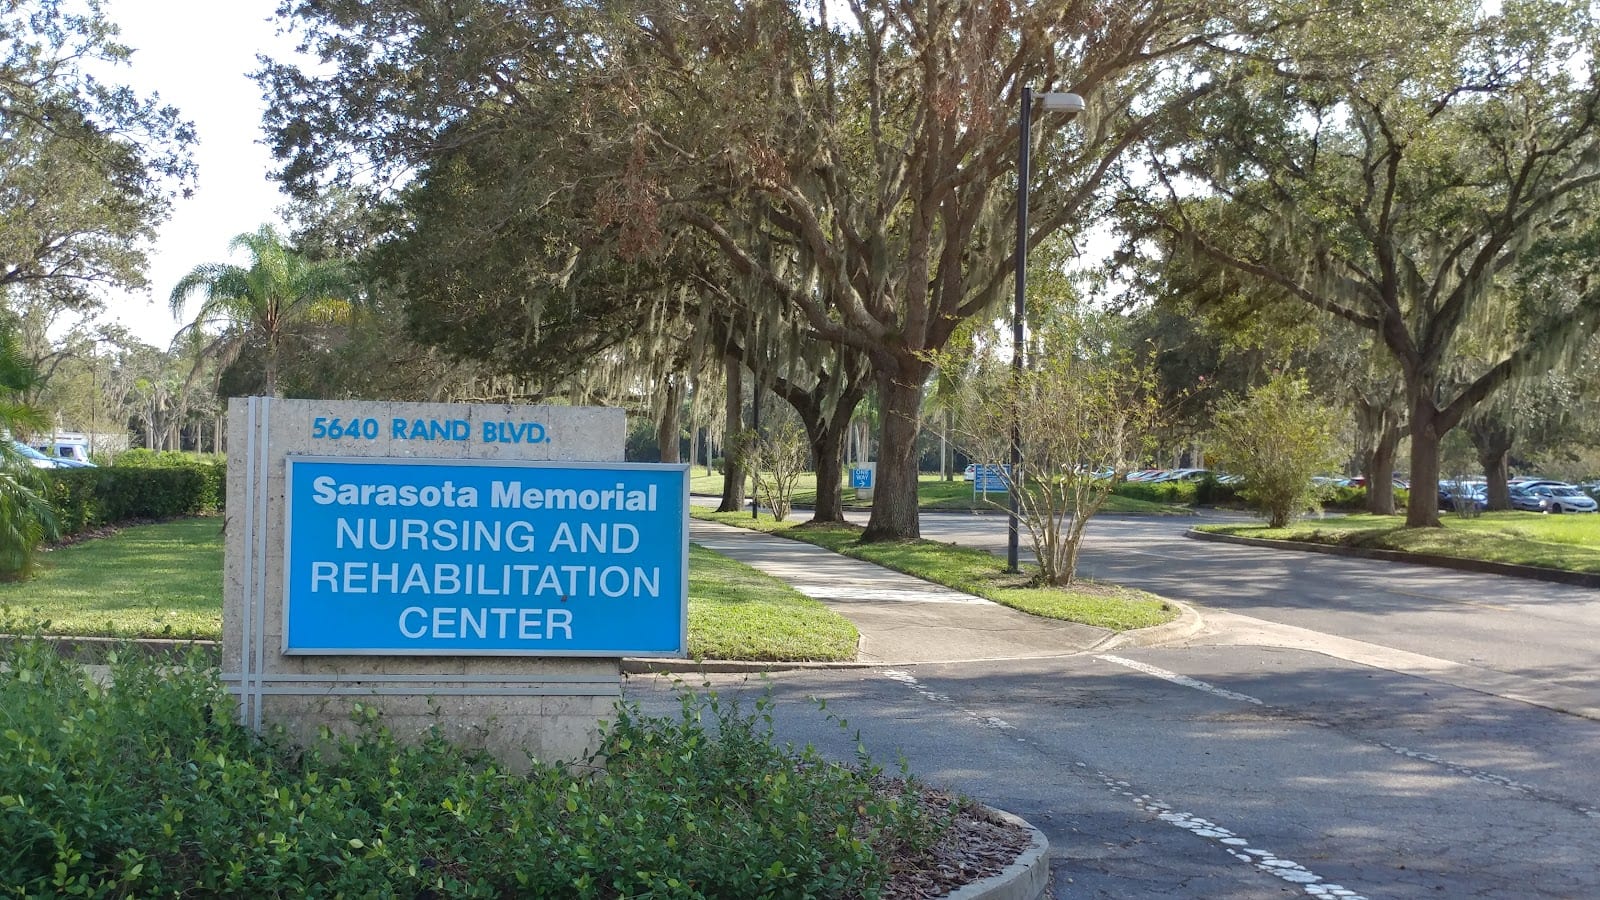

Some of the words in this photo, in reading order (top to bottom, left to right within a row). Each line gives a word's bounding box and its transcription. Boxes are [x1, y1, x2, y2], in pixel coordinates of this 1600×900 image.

[313, 417, 379, 440] 5640
[392, 418, 470, 441] RAND
[483, 421, 551, 443] BLVD.
[313, 476, 478, 508] Sarasota
[491, 480, 657, 511] Memorial
[336, 518, 535, 552] NURSING
[549, 522, 640, 554] AND
[311, 561, 660, 597] REHABILITATION
[399, 606, 573, 640] CENTER
